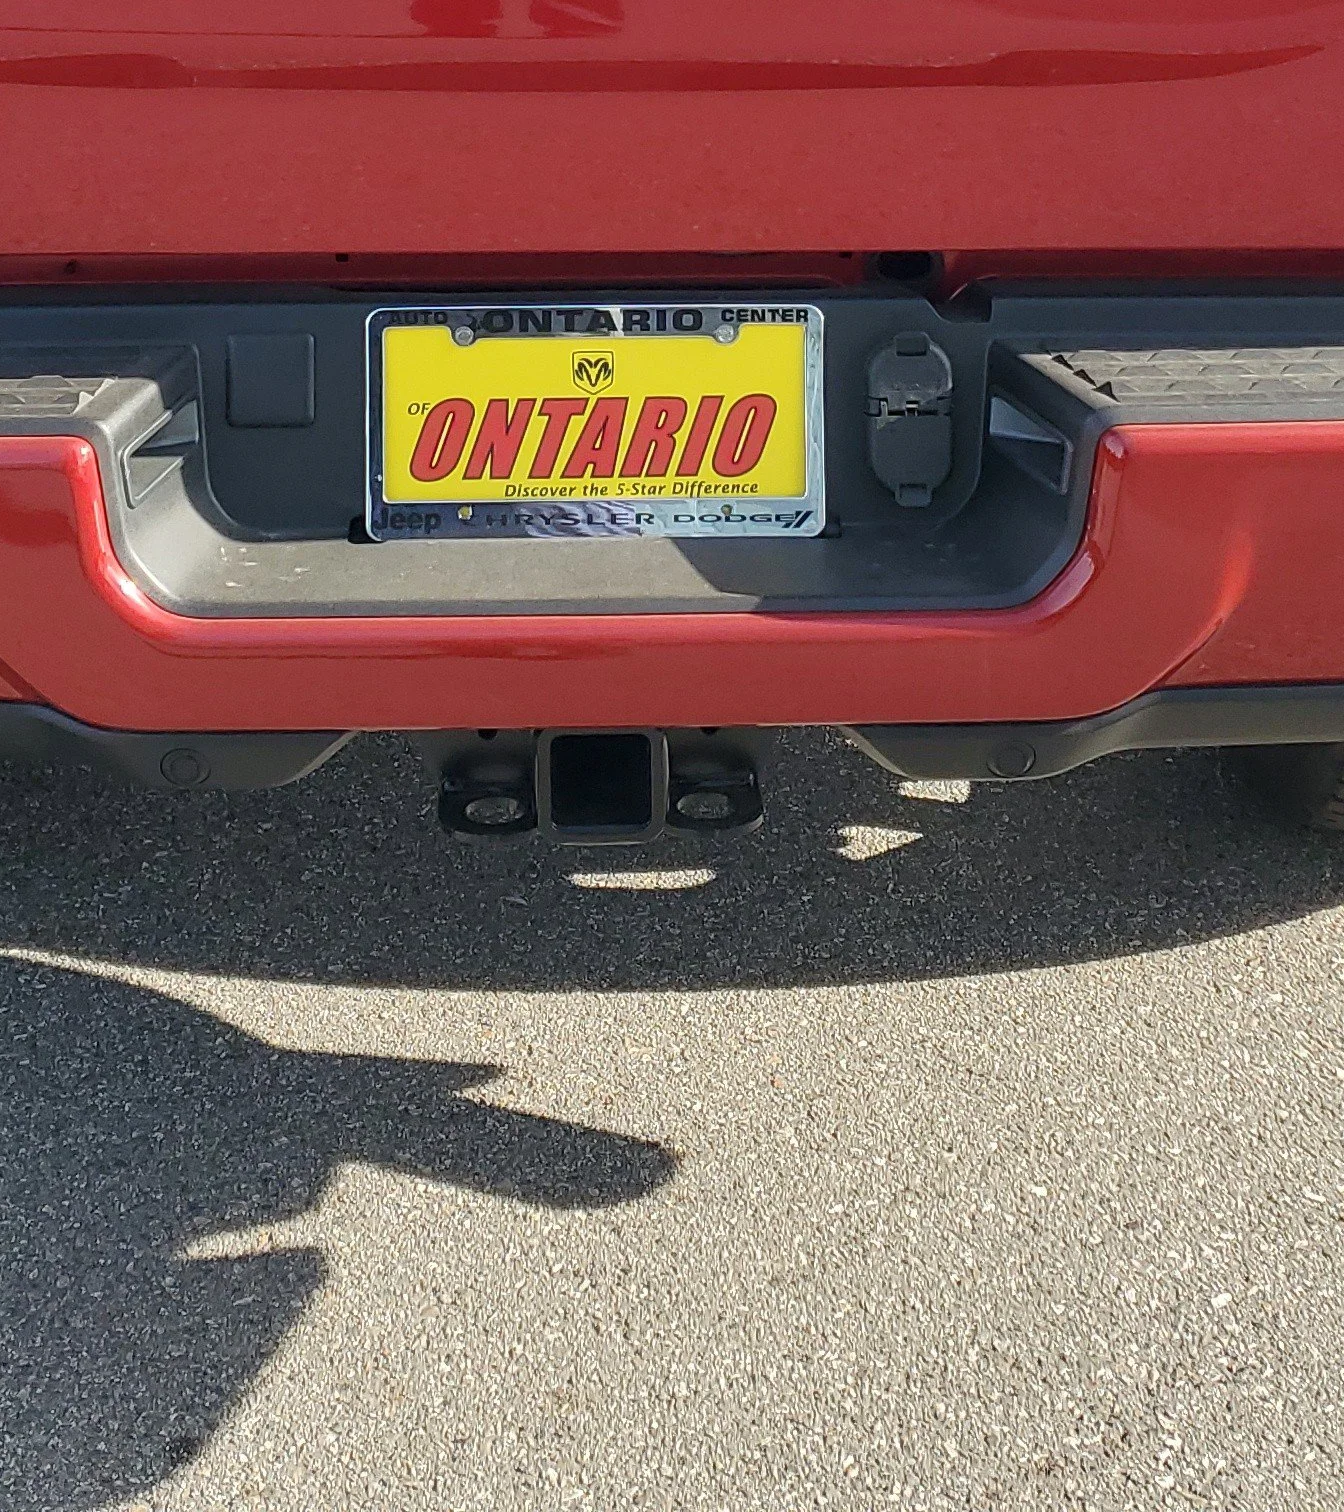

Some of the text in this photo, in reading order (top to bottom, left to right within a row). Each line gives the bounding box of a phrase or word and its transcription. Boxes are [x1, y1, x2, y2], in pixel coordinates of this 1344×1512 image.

[389, 308, 809, 333] AUTO ONTARIO CENTER
[407, 402, 429, 416] OF
[409, 393, 778, 483] ONTARIO
[505, 480, 759, 498] Discover the 5-Star Difference
[372, 507, 442, 534] Jeep
[673, 513, 796, 523] DODGE
